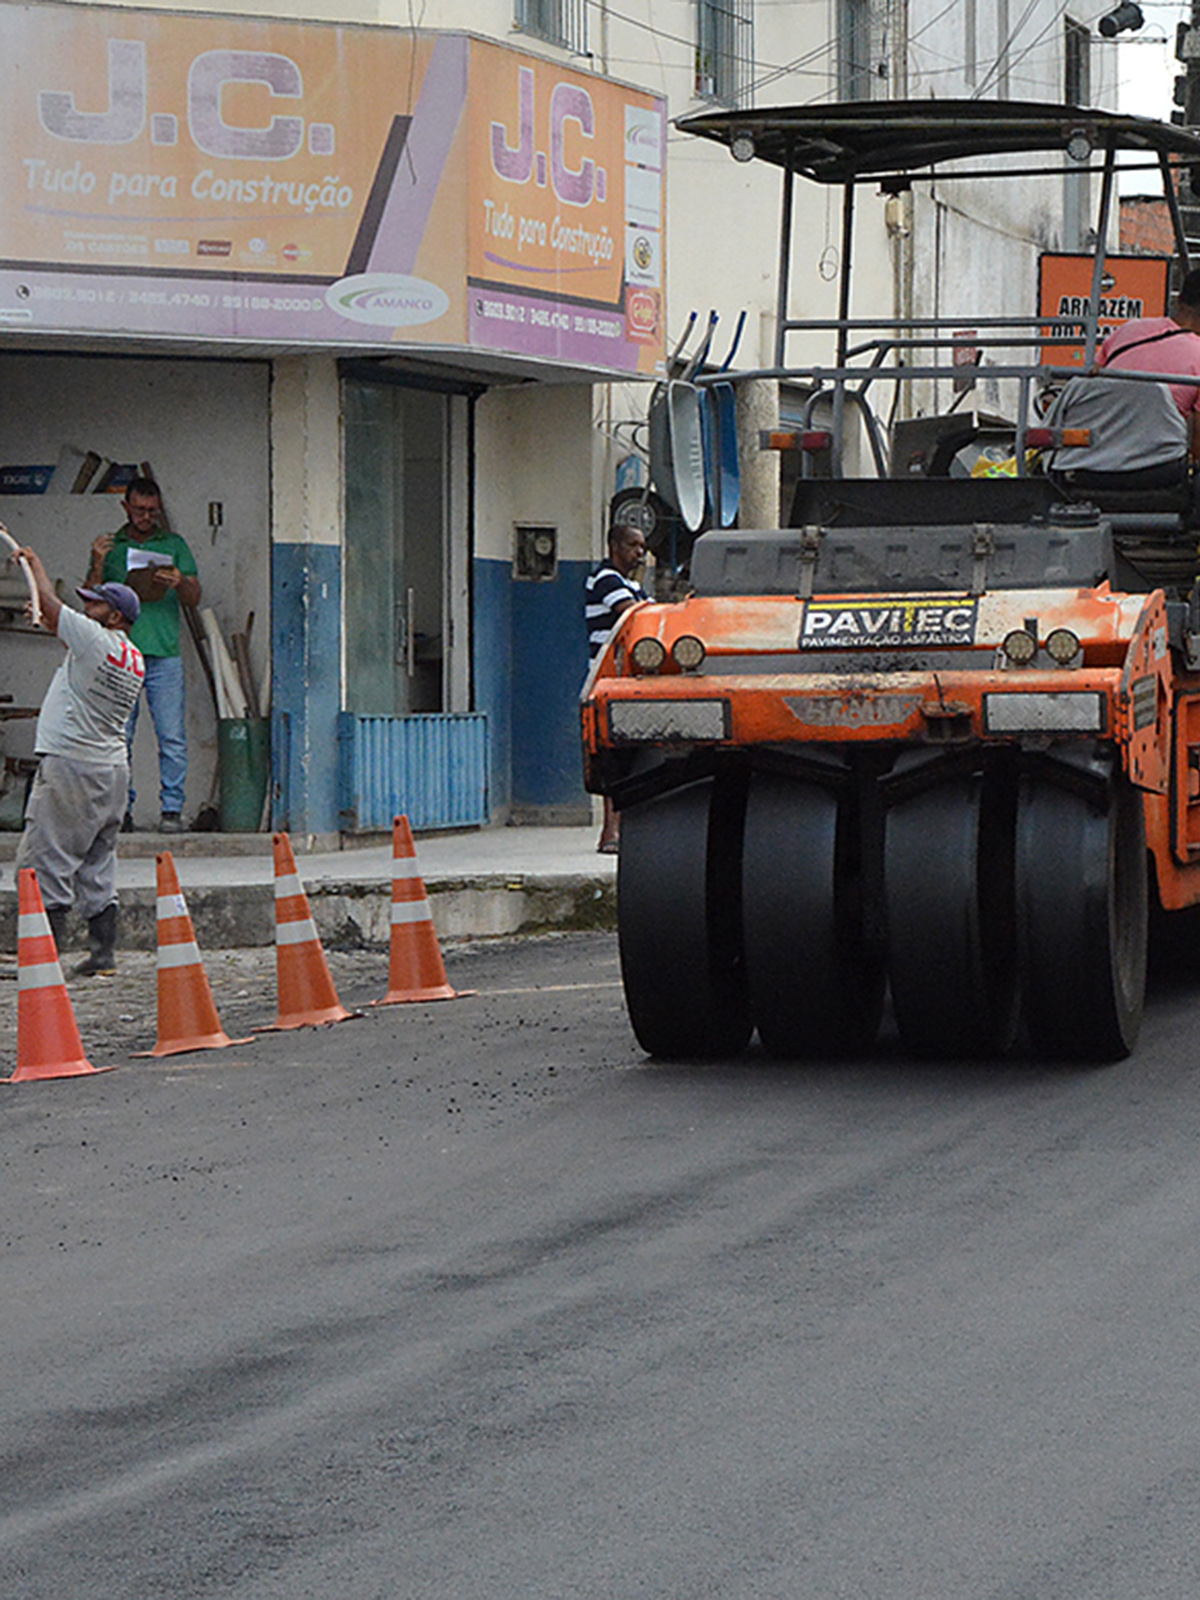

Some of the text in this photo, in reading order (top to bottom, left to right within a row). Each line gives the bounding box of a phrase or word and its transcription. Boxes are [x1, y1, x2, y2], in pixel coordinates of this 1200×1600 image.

[38, 39, 335, 161] J.C.
[490, 65, 606, 208] J.C.
[23, 158, 354, 212] Tudo para Construção
[484, 199, 614, 266] Tudo para Construção
[801, 634, 900, 649] PAVIMENTAÇÃO
[804, 606, 974, 636] PAVITEC
